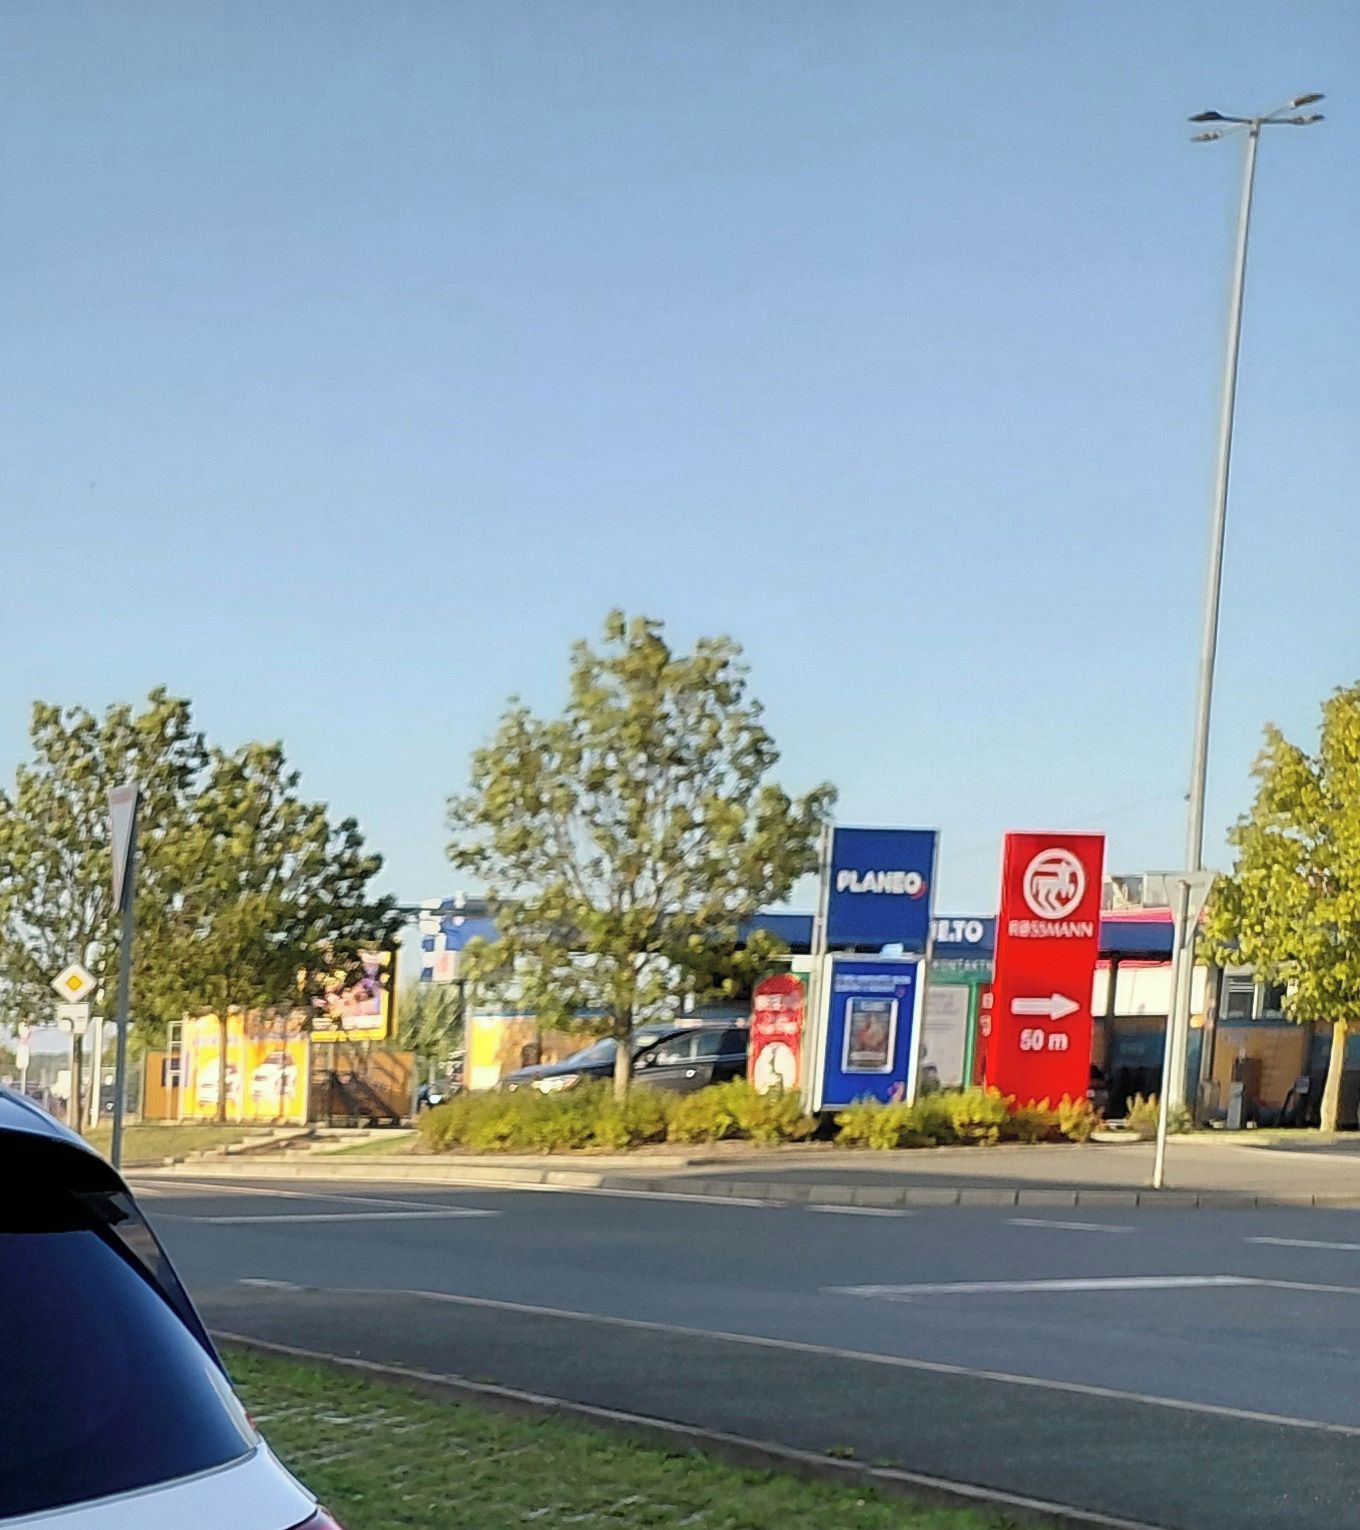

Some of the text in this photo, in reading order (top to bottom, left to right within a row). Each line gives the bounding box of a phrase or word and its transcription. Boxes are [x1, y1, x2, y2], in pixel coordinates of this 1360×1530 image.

[836, 869, 922, 895] PLANEO
[1007, 919, 1094, 938] ROSSMANN
[1019, 1028, 1069, 1051] 50 m
